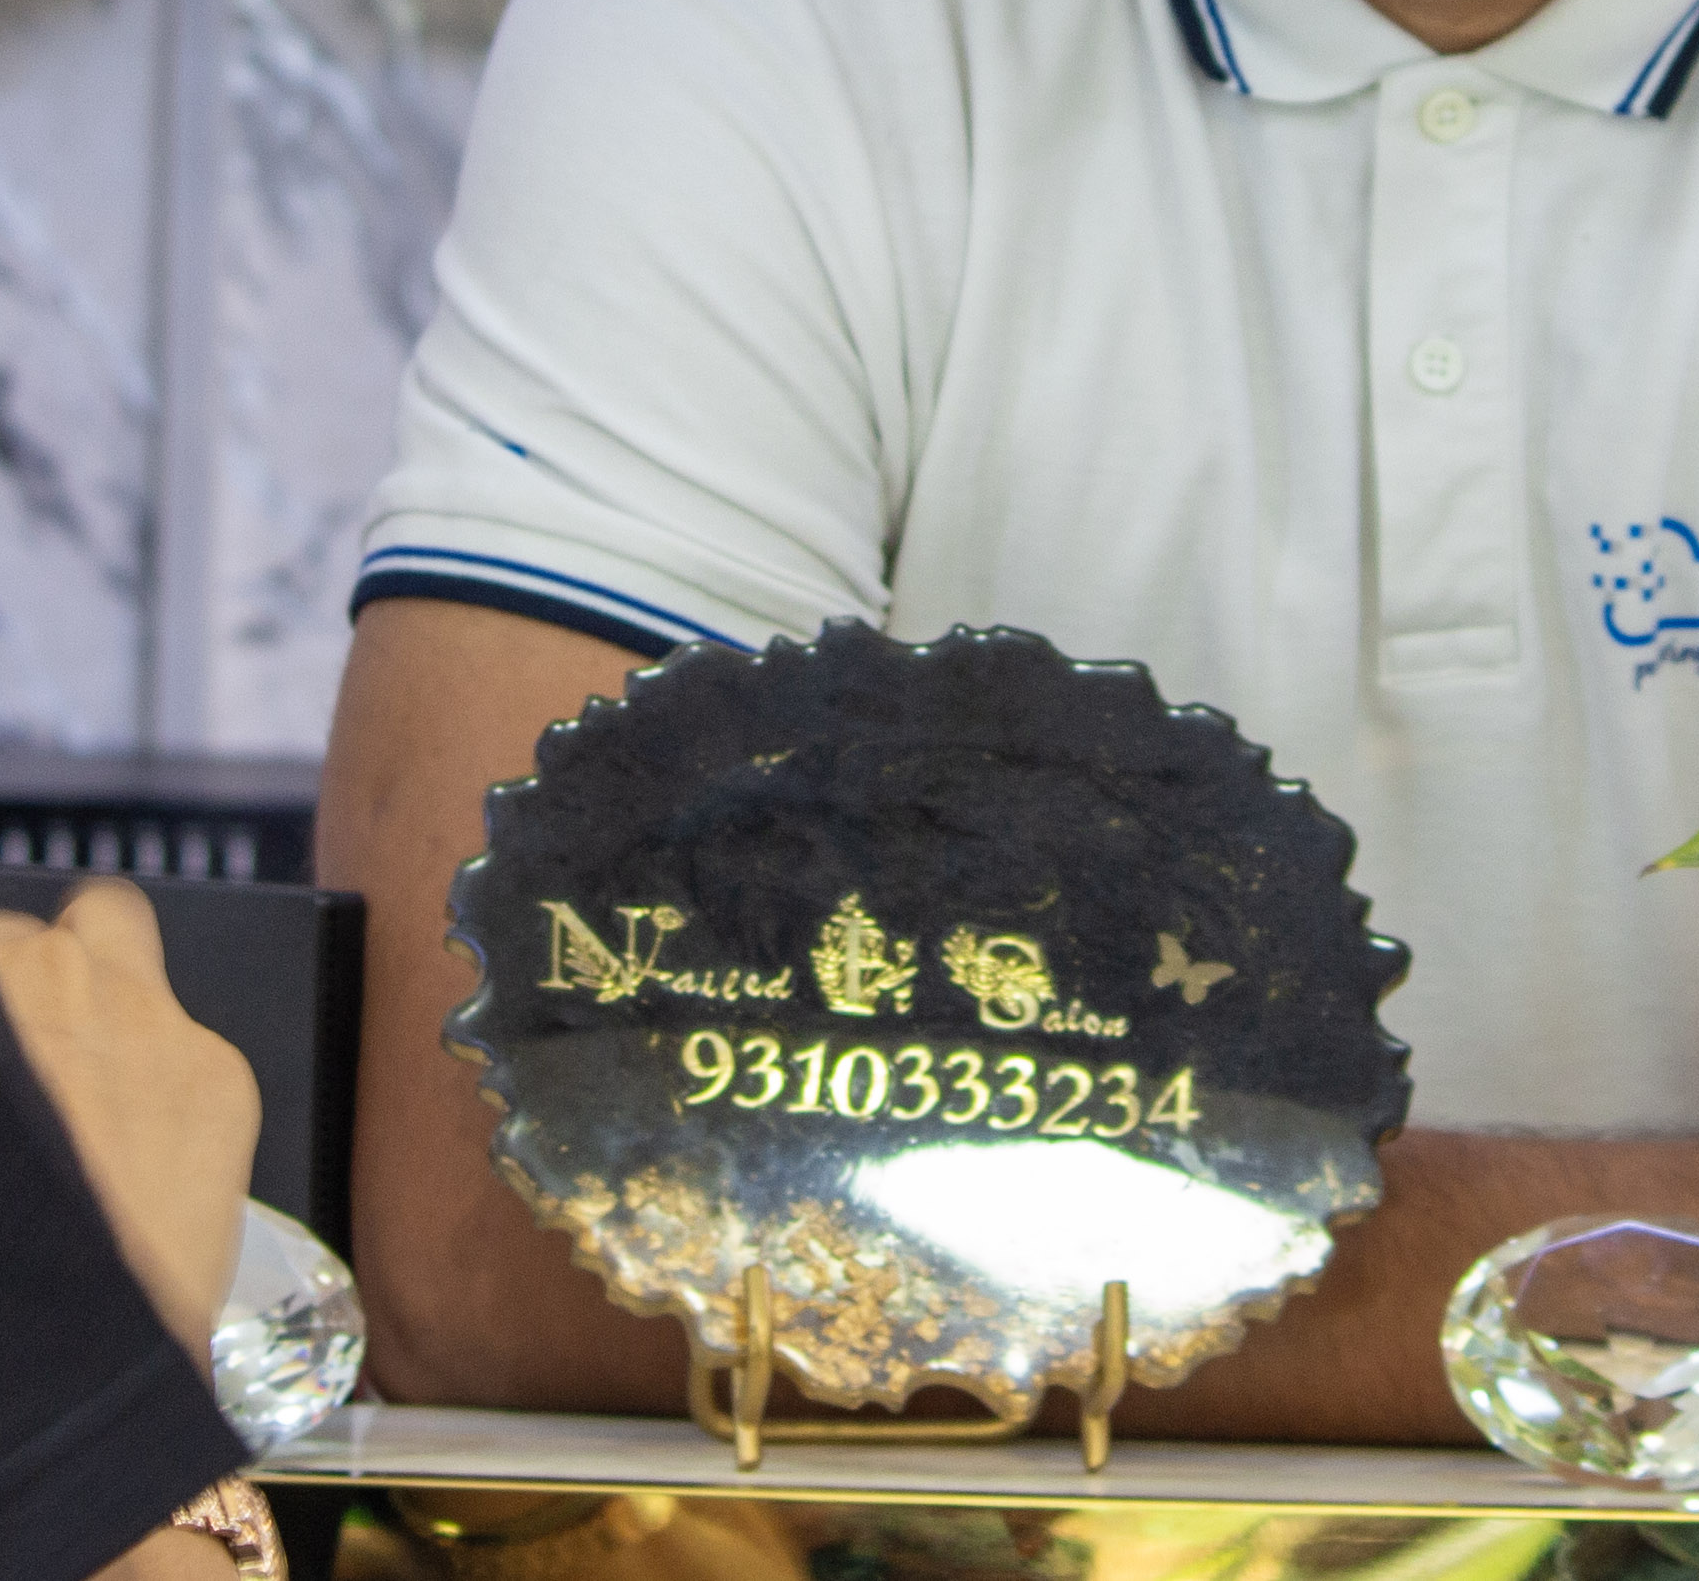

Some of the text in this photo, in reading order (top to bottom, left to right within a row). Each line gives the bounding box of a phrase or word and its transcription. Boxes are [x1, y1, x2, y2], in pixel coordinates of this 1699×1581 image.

[537, 899, 793, 1003] Nailed
[942, 926, 1130, 1038] Salon
[680, 1028, 1201, 1139] 9310333234
